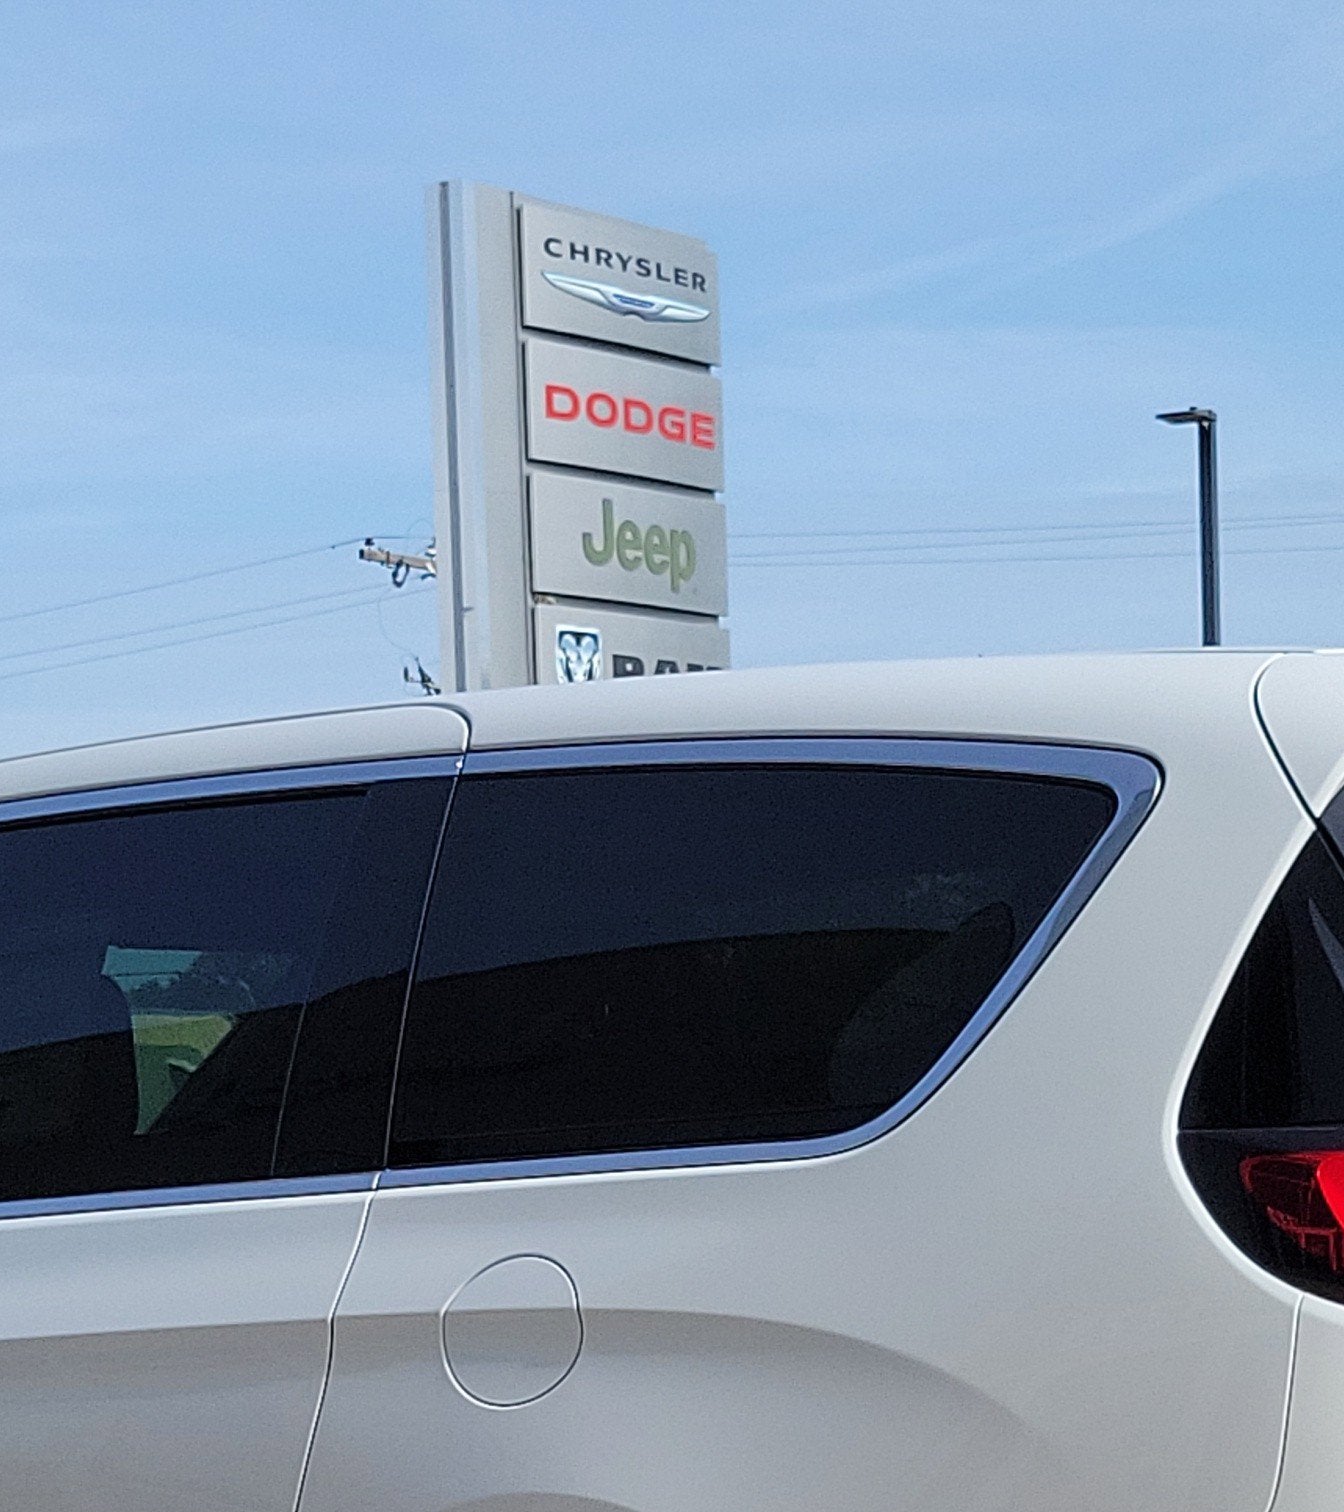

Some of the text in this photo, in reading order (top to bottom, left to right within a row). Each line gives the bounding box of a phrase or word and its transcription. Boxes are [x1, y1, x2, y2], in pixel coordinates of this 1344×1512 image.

[543, 237, 707, 293] CHRYSLER
[544, 384, 716, 450] DODGE
[582, 498, 697, 594] Jeep
